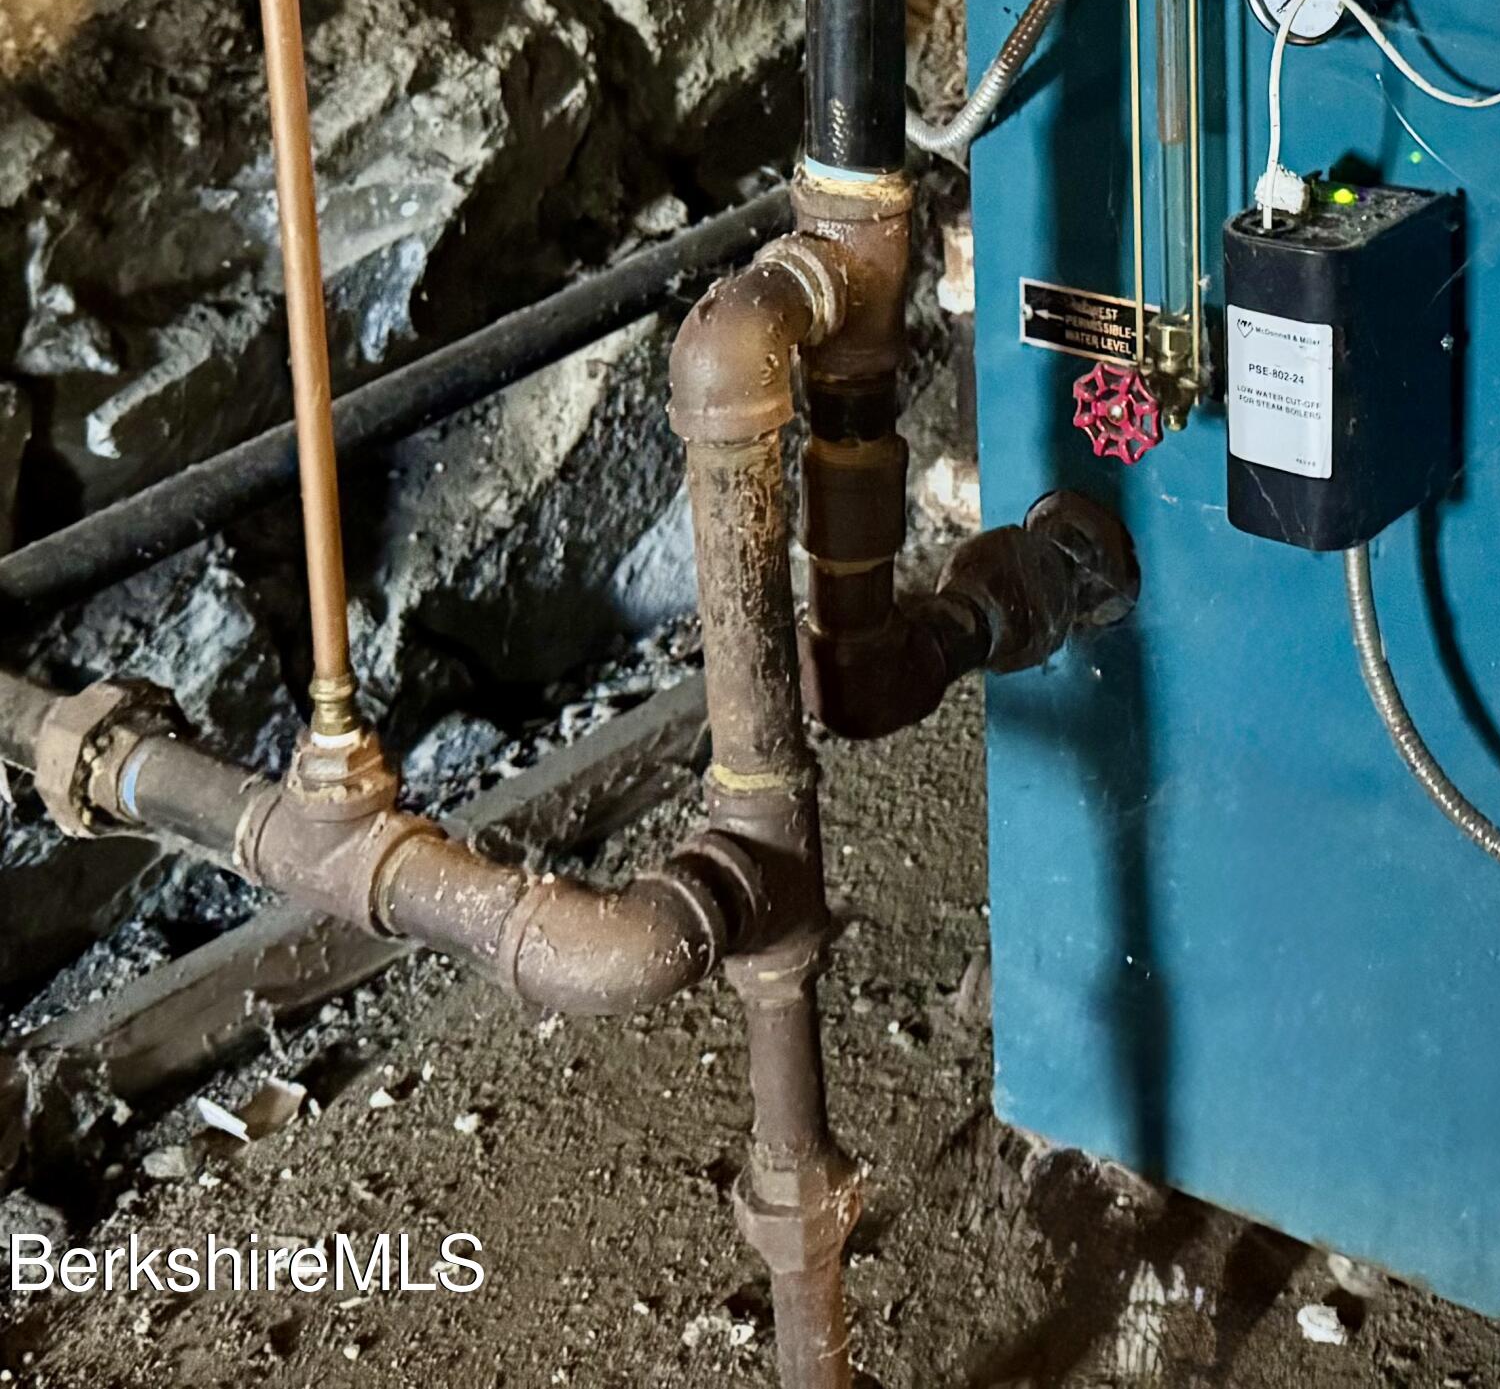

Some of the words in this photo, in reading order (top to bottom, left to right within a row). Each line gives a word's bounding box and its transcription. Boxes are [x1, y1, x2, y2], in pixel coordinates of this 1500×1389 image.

[1101, 337, 1132, 354] LEVEL
[1249, 363, 1304, 384] PSE-802-24
[1237, 385, 1253, 394] LOW
[1256, 390, 1283, 401] WATER
[1285, 396, 1320, 409] CUT-OFF
[1239, 394, 1254, 404] FOR
[1256, 399, 1283, 411] STEAM
[1285, 406, 1321, 420] BOILERS
